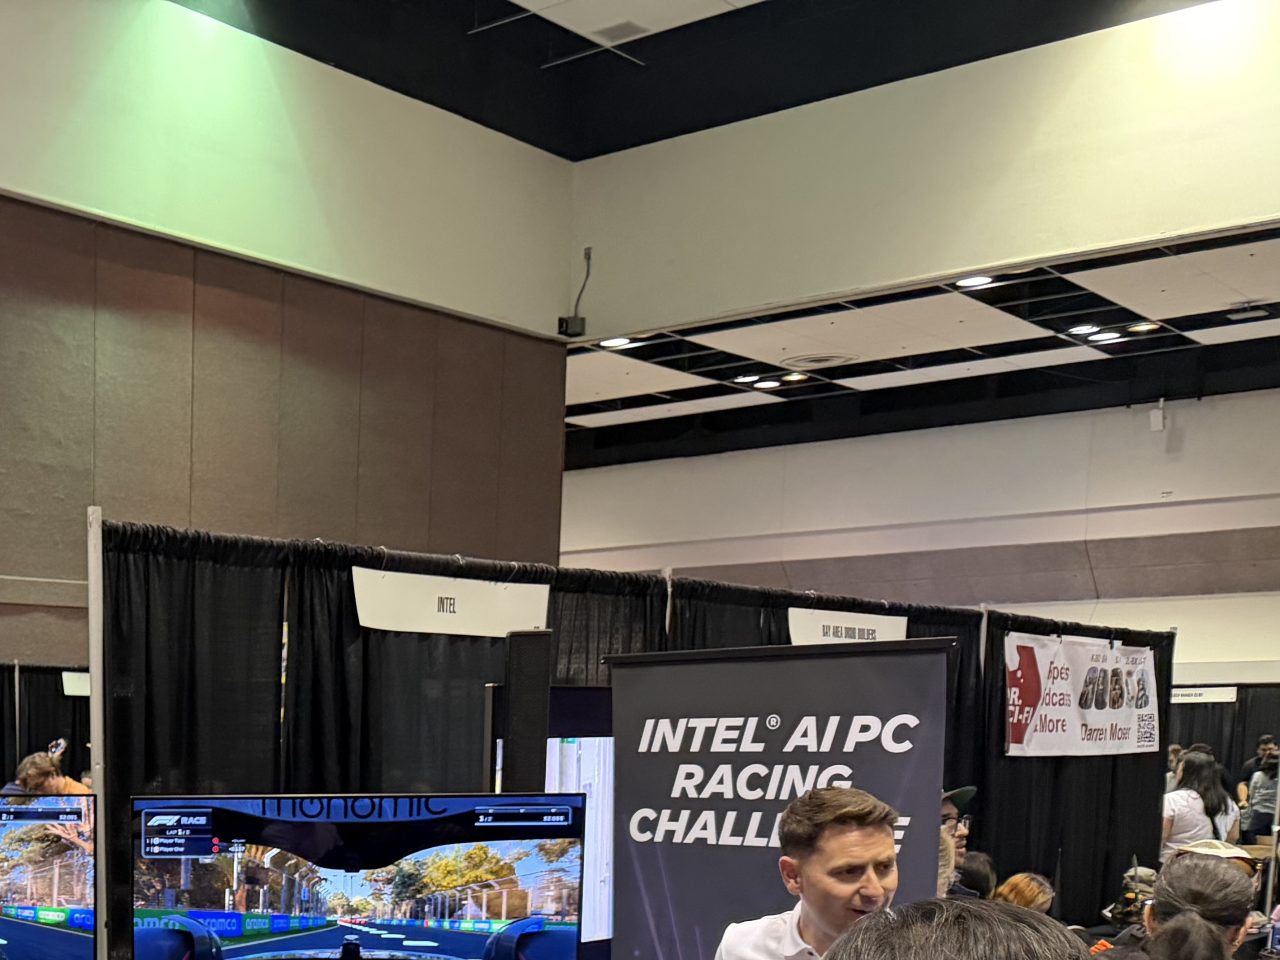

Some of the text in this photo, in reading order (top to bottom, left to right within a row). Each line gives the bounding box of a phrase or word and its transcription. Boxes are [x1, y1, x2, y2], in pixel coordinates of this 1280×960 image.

[437, 597, 456, 614] INTEL
[782, 716, 841, 753] AI
[842, 713, 920, 754] PC
[181, 817, 207, 825] RACE
